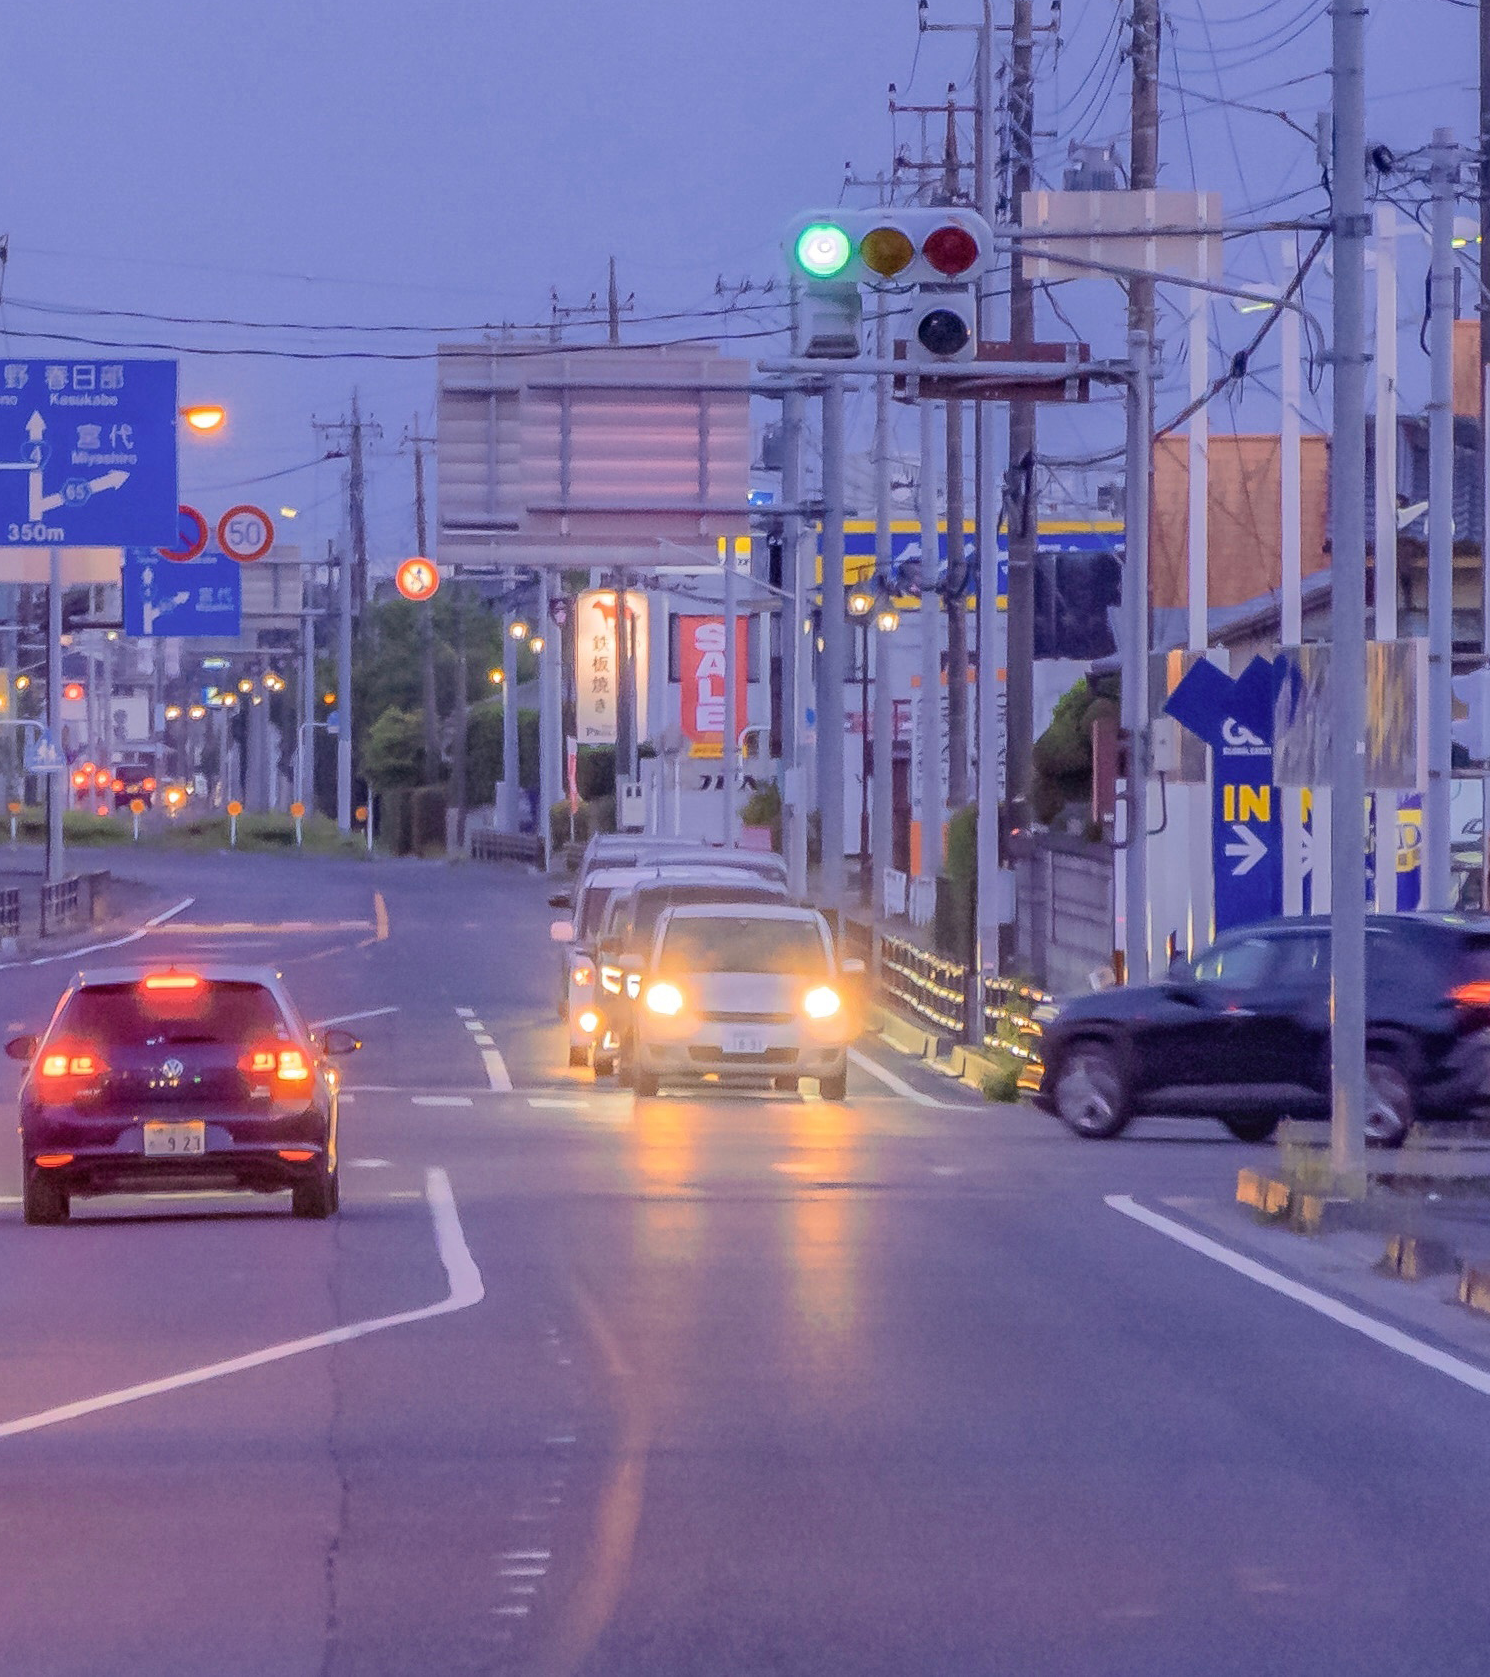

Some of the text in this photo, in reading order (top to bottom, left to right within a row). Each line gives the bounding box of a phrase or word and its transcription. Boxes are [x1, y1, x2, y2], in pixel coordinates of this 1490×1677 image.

[7, 522, 65, 542] 350m
[229, 521, 261, 547] 50
[1223, 784, 1271, 822] IN
